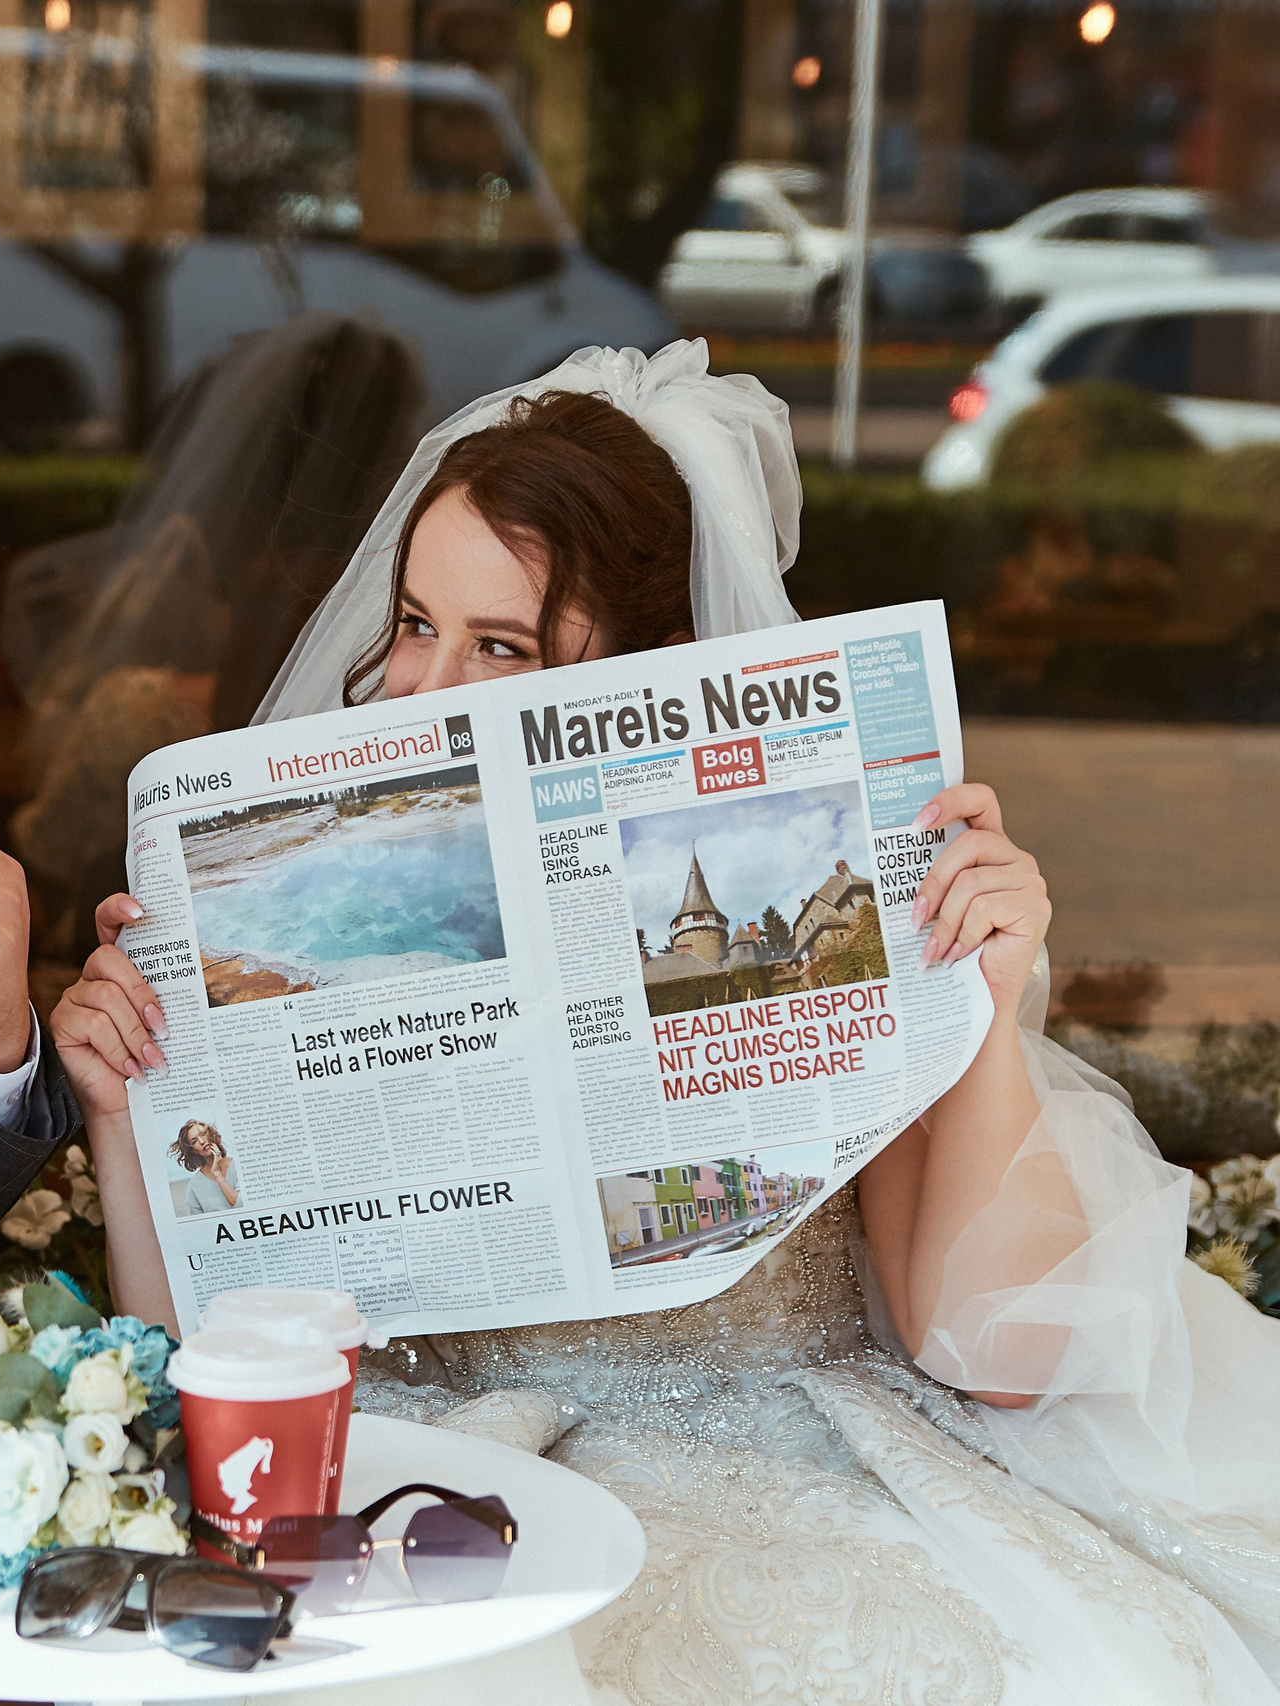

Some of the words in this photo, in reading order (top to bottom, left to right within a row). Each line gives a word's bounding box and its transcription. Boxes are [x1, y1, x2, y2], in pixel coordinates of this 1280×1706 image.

[848, 643, 873, 656] Weird
[873, 638, 902, 652] Reptile
[798, 653, 825, 664] December
[850, 655, 880, 668] Caught
[880, 651, 907, 662] Eating
[852, 665, 894, 680] Crocodile.
[894, 661, 920, 673] Watch
[854, 682, 873, 695] your
[874, 677, 895, 689] kids!
[563, 696, 613, 711] MNODAY'S
[613, 688, 641, 704] ADILY
[520, 688, 690, 766] Mareis
[700, 671, 841, 734] News
[450, 731, 472, 750] 08
[765, 737, 799, 752] TEMPUS
[799, 735, 816, 745] VEL
[817, 730, 843, 743] IPSUM
[267, 723, 442, 782] International
[701, 745, 754, 769] Bolg
[767, 752, 788, 764] NAM
[789, 747, 819, 759] TELLUS
[602, 767, 641, 778] HEADING
[640, 758, 681, 772] DURSTOR
[865, 760, 888, 769] FINANCE
[888, 758, 903, 766] NEWS
[867, 764, 916, 781] HEADING
[176, 772, 232, 797] Nwes
[604, 776, 645, 790] ADIPISING
[645, 770, 674, 784] ATORA
[701, 767, 761, 790] nwes
[869, 777, 905, 792] DURST
[907, 772, 941, 785] ORADI
[133, 780, 171, 816] Mauris
[535, 775, 597, 809] NAWS
[871, 788, 907, 802] PISING
[539, 823, 609, 845] HEADLINE
[874, 827, 946, 853] INTERUDM
[541, 842, 579, 859] DURS
[877, 848, 933, 870] COSTUR
[543, 856, 579, 872] ISING
[545, 863, 612, 885] ATORASA
[879, 866, 931, 889] NVENE
[883, 886, 918, 907] DIAM
[128, 939, 190, 960] REFRIGERATORS
[139, 958, 161, 974] VISIT
[162, 956, 174, 967] TO
[174, 952, 193, 965] THE
[142, 971, 169, 985] OWER
[170, 965, 197, 980] SHOW
[566, 996, 624, 1017] ANOTHER
[567, 1013, 593, 1026] HEA
[595, 1008, 624, 1021] DING
[653, 1002, 783, 1045] HEADLINE
[788, 984, 888, 1023] RISPOIT
[291, 1028, 336, 1053] Last
[340, 1018, 393, 1045] week
[397, 1010, 465, 1035] Nature
[471, 997, 519, 1023] Park
[570, 1021, 619, 1042] DURSTO
[570, 1028, 631, 1050] ADIPISING
[658, 1045, 697, 1074] NIT
[704, 1026, 821, 1066] CUMSCIS
[827, 1013, 897, 1046] NATO
[296, 1053, 343, 1081] Held
[348, 1056, 361, 1072] a
[365, 1041, 434, 1070] Flower
[440, 1032, 497, 1056] Show
[662, 1064, 764, 1102] MAGNIS
[769, 1047, 866, 1084] DISARE
[835, 1122, 890, 1154] HEADING
[216, 1223, 235, 1244] A
[239, 1199, 392, 1240] BEAUTIFUL
[398, 1182, 514, 1216] FLOWER
[376, 1228, 400, 1236] turbulent
[341, 1259, 367, 1268] outbreaks
[384, 1254, 403, 1262] horrific
